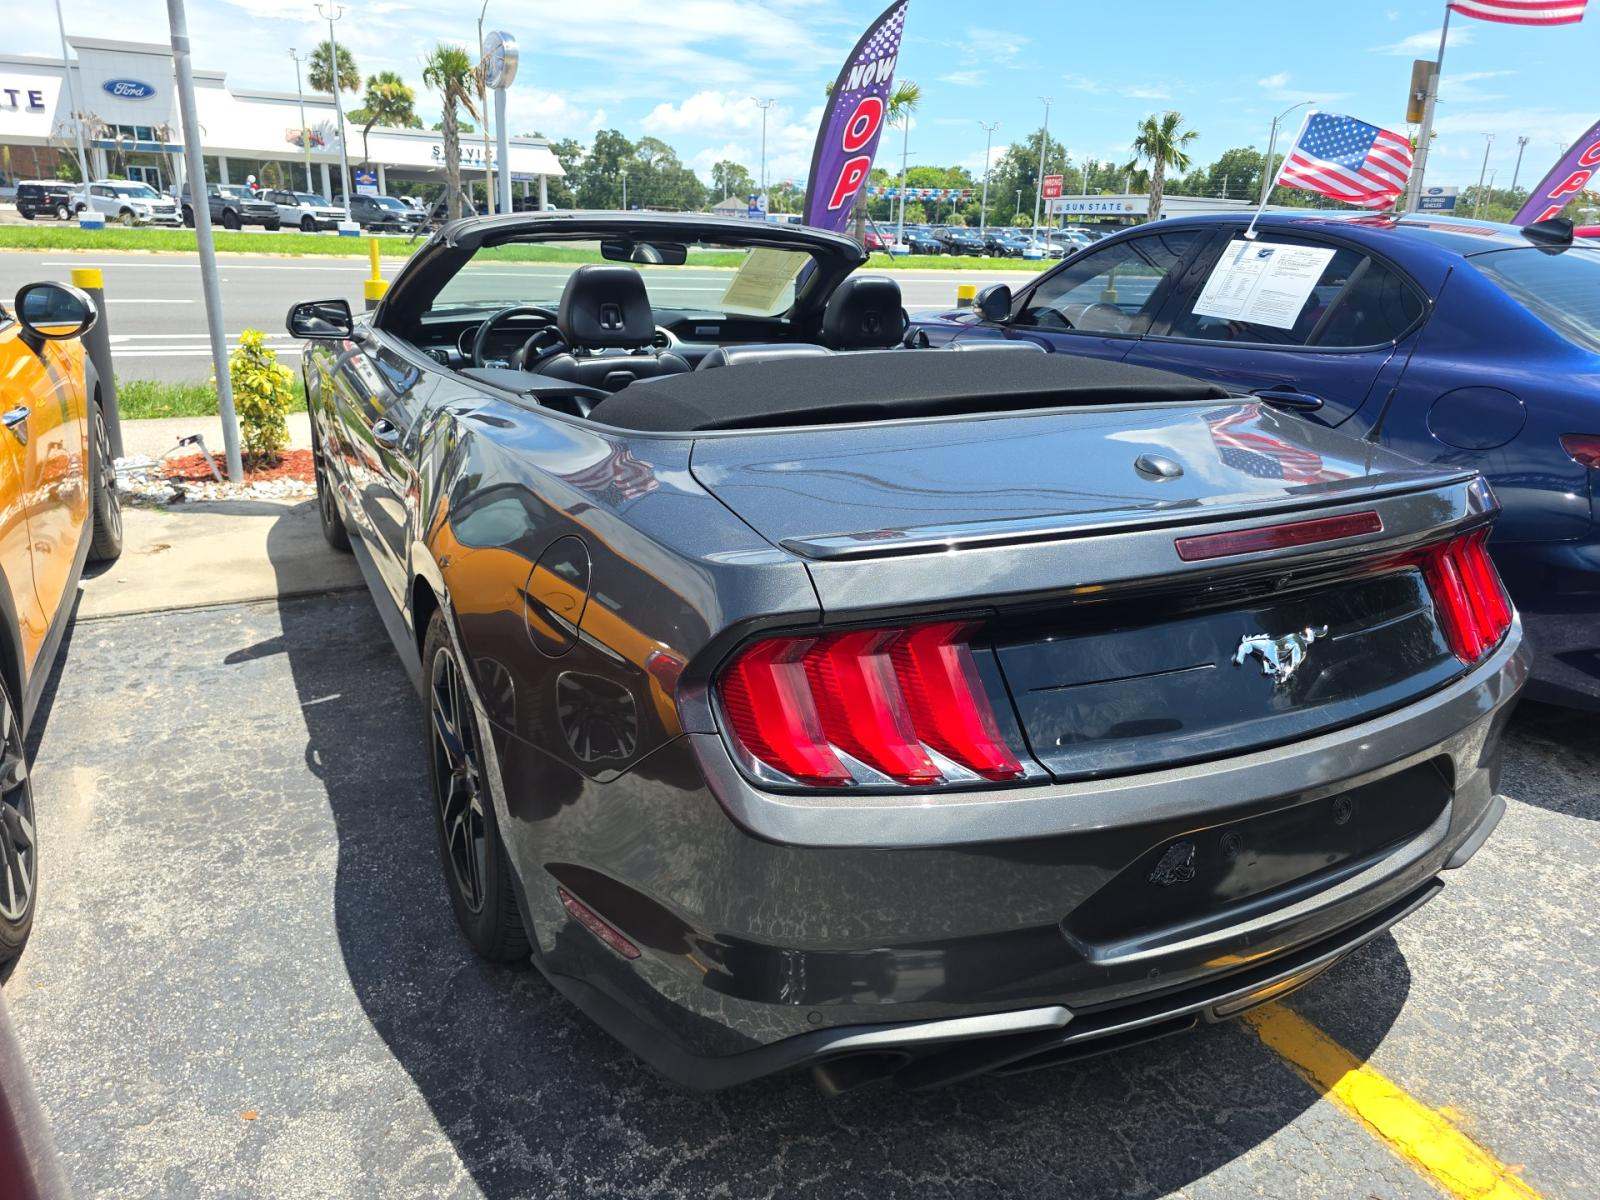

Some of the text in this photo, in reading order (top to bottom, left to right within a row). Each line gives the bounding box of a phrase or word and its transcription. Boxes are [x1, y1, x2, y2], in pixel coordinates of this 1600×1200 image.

[845, 56, 896, 91] NOW
[114, 82, 144, 97] Ford
[1532, 140, 1600, 223] OP
[1065, 203, 1088, 211] SUN
[1088, 203, 1121, 211] STATE
